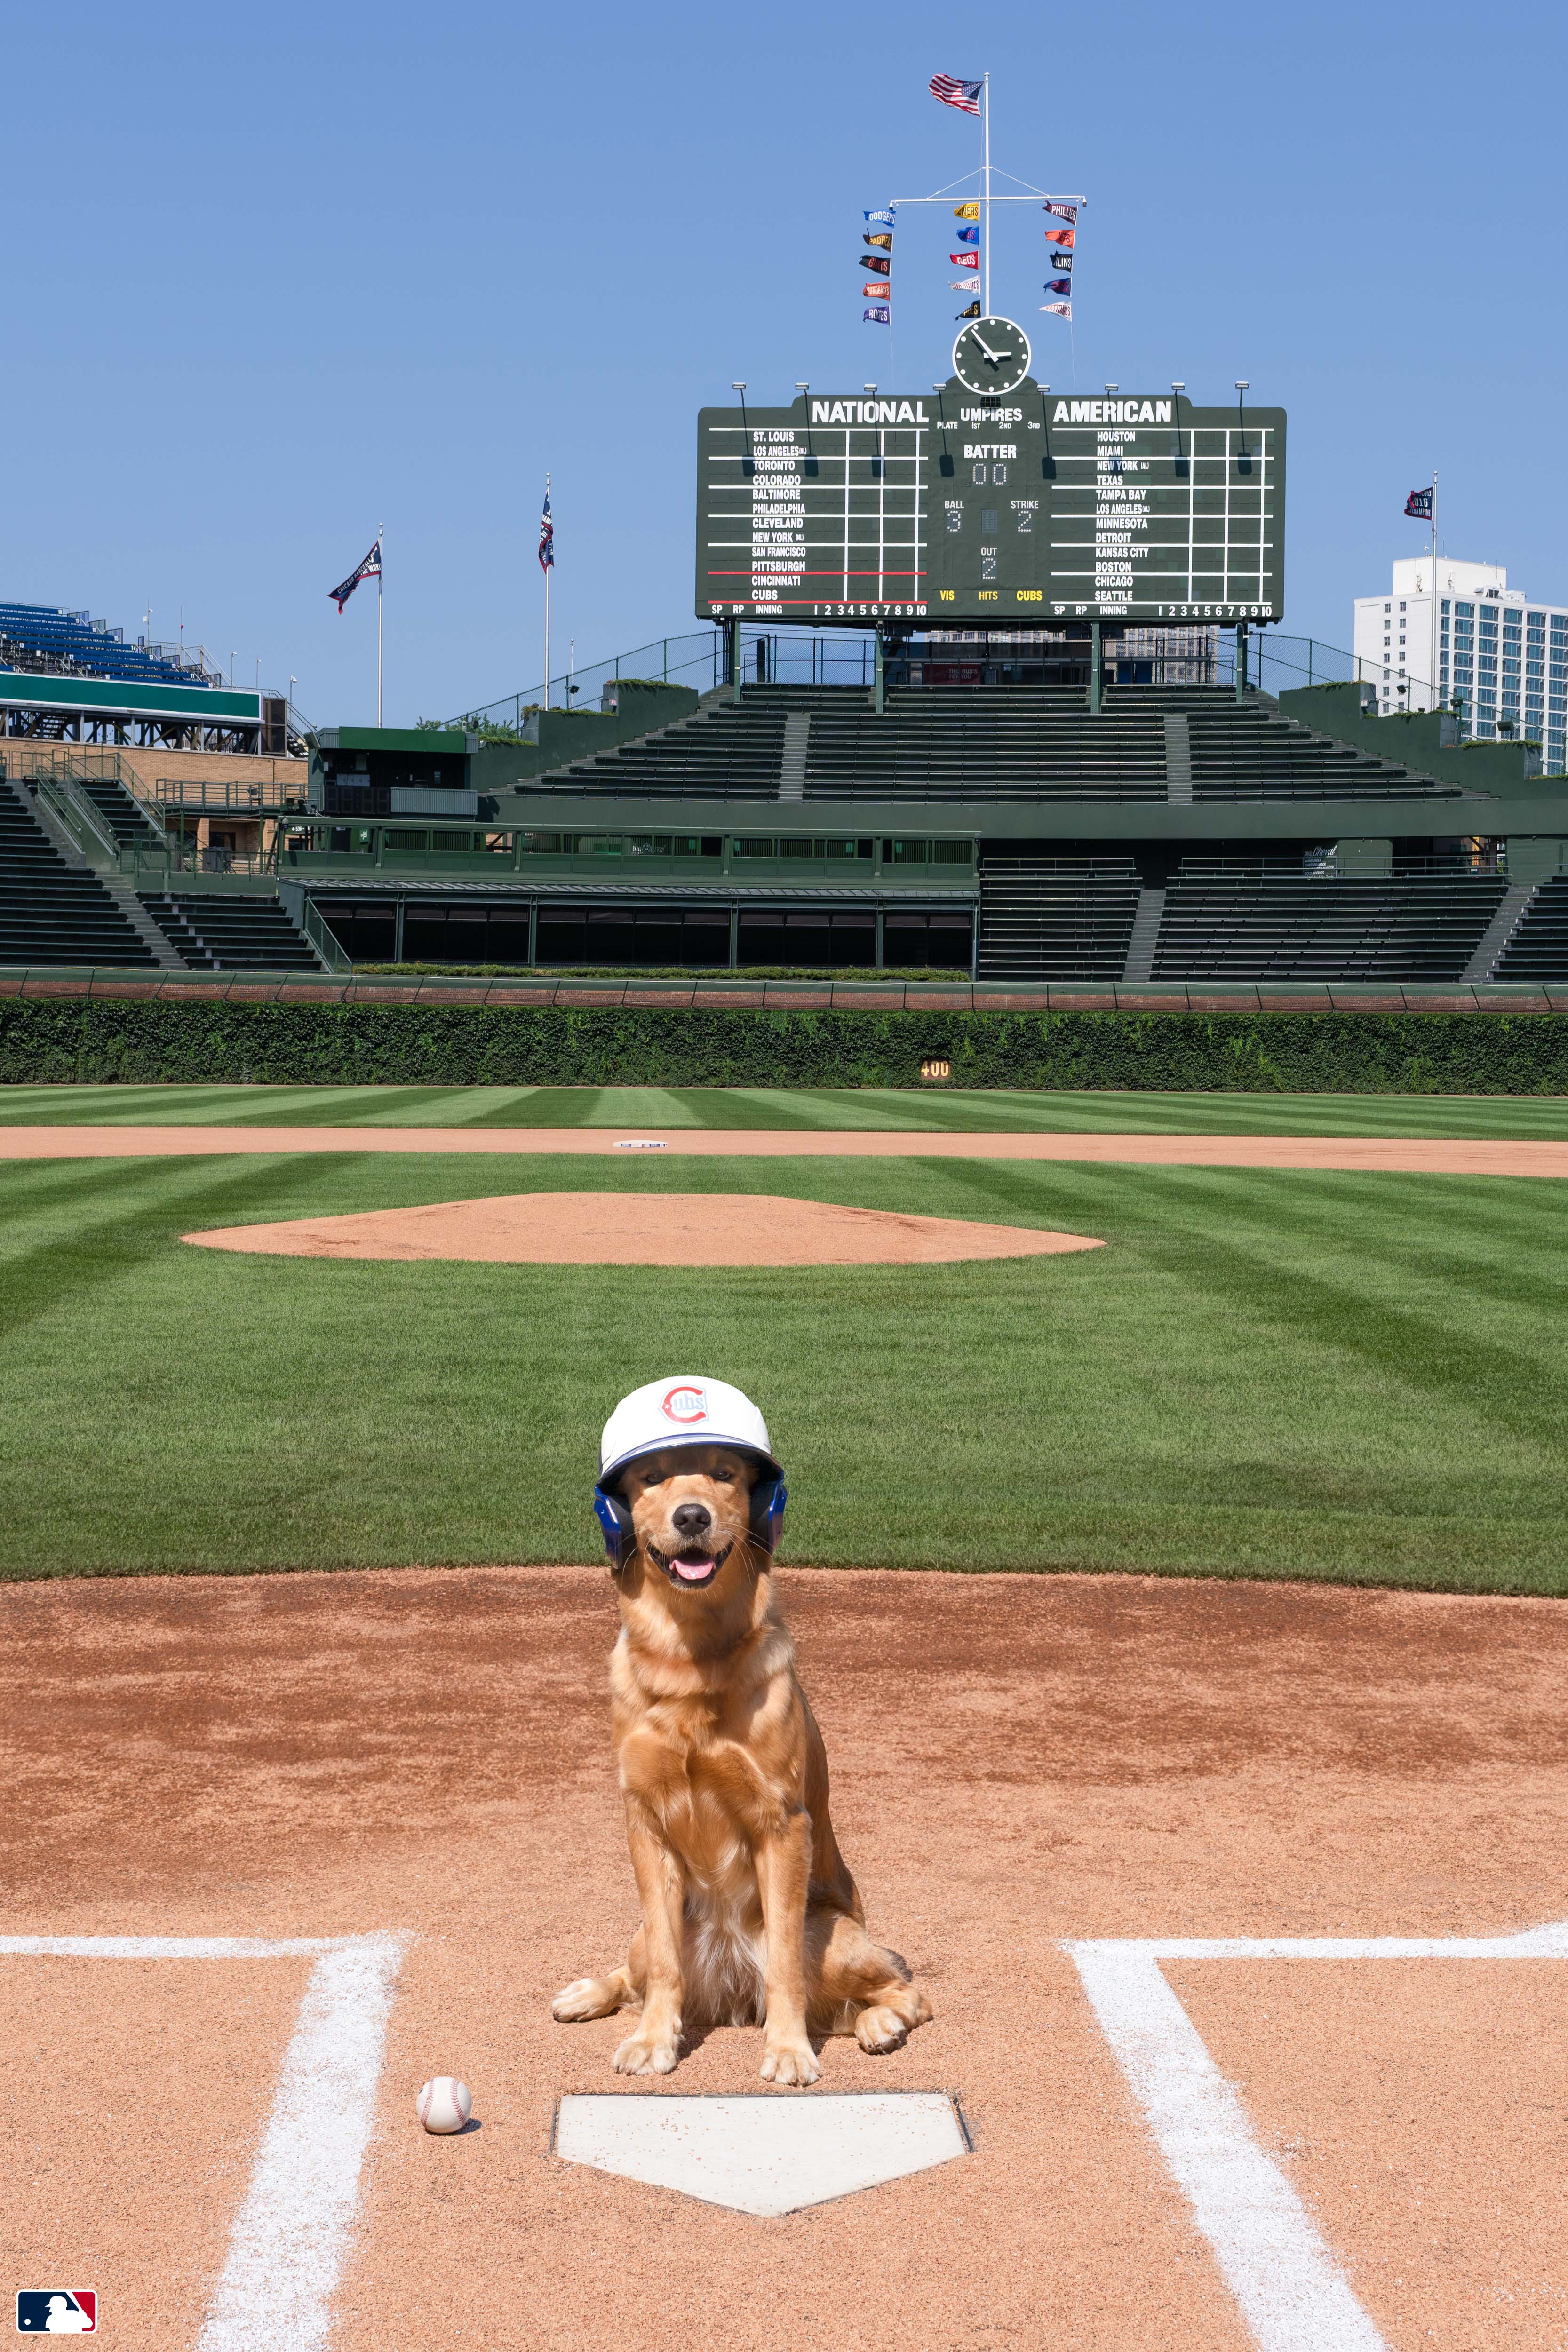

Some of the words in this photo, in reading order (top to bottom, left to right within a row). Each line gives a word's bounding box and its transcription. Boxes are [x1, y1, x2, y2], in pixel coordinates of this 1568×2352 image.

[869, 211, 895, 224] DODGERS
[1051, 206, 1076, 221] PHILLIES
[869, 236, 890, 247] PADRES
[957, 255, 975, 265] REDS
[812, 401, 929, 423] NATIONAL
[961, 408, 1022, 421] UMPIRES
[1053, 401, 1171, 422] AMERICAN
[754, 431, 766, 442] ST.
[769, 431, 794, 442] LOUIS
[1098, 431, 1135, 442] HOUSTON
[754, 446, 766, 456] LOS
[964, 445, 1016, 458] BATTER
[1097, 446, 1123, 456] MIAMI
[754, 461, 795, 470] TORONTO
[1097, 461, 1114, 471] NEW
[1117, 461, 1138, 471] YORK
[753, 475, 800, 485] COLORADO
[1097, 475, 1122, 486] TEXAS
[753, 489, 800, 499] BALTIMORE
[1096, 490, 1126, 500] TAMPA
[1129, 490, 1146, 500] BAY
[753, 504, 805, 514] PHILADELPHIA
[1097, 504, 1109, 514] LOS
[753, 518, 803, 528] CLEVELAND
[947, 511, 960, 532] 3
[1018, 511, 1031, 532] 2
[1097, 518, 1147, 529] MINNESOTA
[753, 532, 770, 542] NEW
[772, 532, 793, 543] YORK
[1096, 533, 1131, 543] DETROIT
[752, 547, 765, 557] SAN
[768, 547, 805, 557] FRANCISCO
[1096, 547, 1128, 557] KANSAS
[1130, 548, 1149, 557] CITY
[752, 561, 805, 571] PITTSBURGH
[983, 558, 995, 579] 2
[1096, 562, 1131, 572] BOSTON
[337, 577, 354, 594] CHICAGO
[752, 575, 800, 586] CINCINNATI
[1095, 576, 1133, 587] CHICAGO
[752, 590, 778, 600] CUBS
[940, 590, 954, 600] VIS
[979, 591, 998, 600] HITS
[1017, 590, 1042, 601] CUBS
[1095, 591, 1132, 601] SEATTLE
[712, 605, 722, 614] SP
[756, 605, 782, 614] INNING
[825, 605, 831, 615] 2
[838, 605, 844, 615] 3
[848, 605, 854, 615] 4
[860, 605, 866, 615] 5
[872, 605, 878, 615] 6
[884, 605, 890, 615] 7
[895, 605, 901, 615] 8
[907, 605, 913, 615] 9
[917, 605, 926, 615] 10
[1054, 606, 1065, 614] SP
[1076, 606, 1087, 614] RP
[1100, 606, 1127, 614] INNING
[1169, 606, 1175, 616] 2
[1181, 606, 1187, 616] 3
[1192, 606, 1199, 616] 4
[1204, 606, 1210, 616] 5
[1216, 606, 1222, 616] 6
[1228, 606, 1234, 616] 7
[1240, 606, 1246, 616] 8
[1251, 606, 1258, 616] 9
[1262, 606, 1272, 616] 10
[1313, 845, 1337, 856] Cheval
[921, 1061, 949, 1077] 400
[662, 1386, 707, 1423] Cubs
